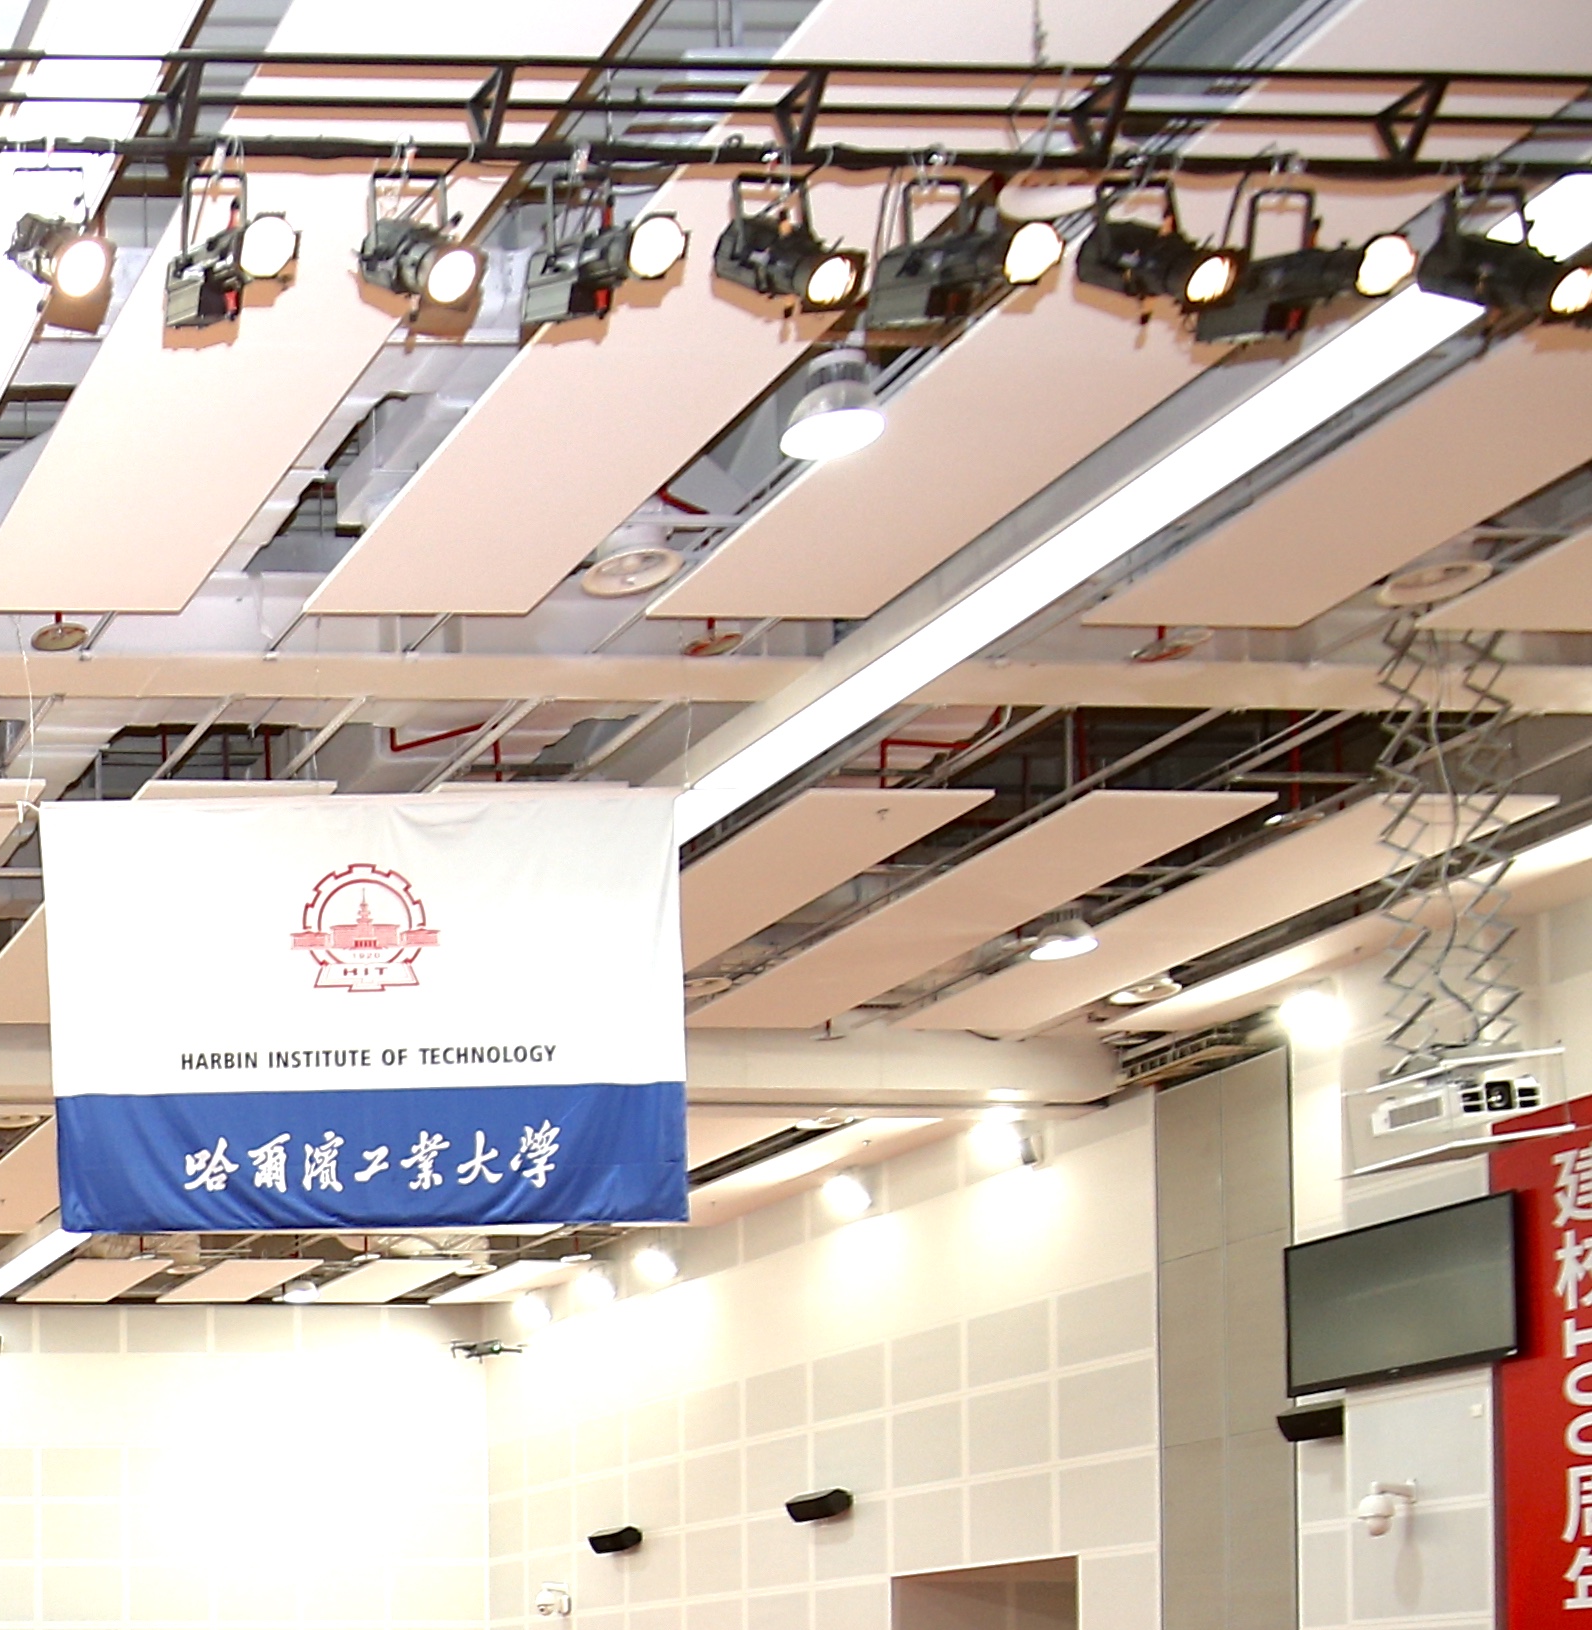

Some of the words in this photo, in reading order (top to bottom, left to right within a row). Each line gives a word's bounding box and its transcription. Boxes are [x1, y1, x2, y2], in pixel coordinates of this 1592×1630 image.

[342, 966, 388, 976] HIT
[181, 1051, 258, 1071] HARBIN
[268, 1048, 371, 1069] INSTITUTE
[381, 1047, 408, 1067] OF
[418, 1044, 557, 1066] TECHNOLOGY
